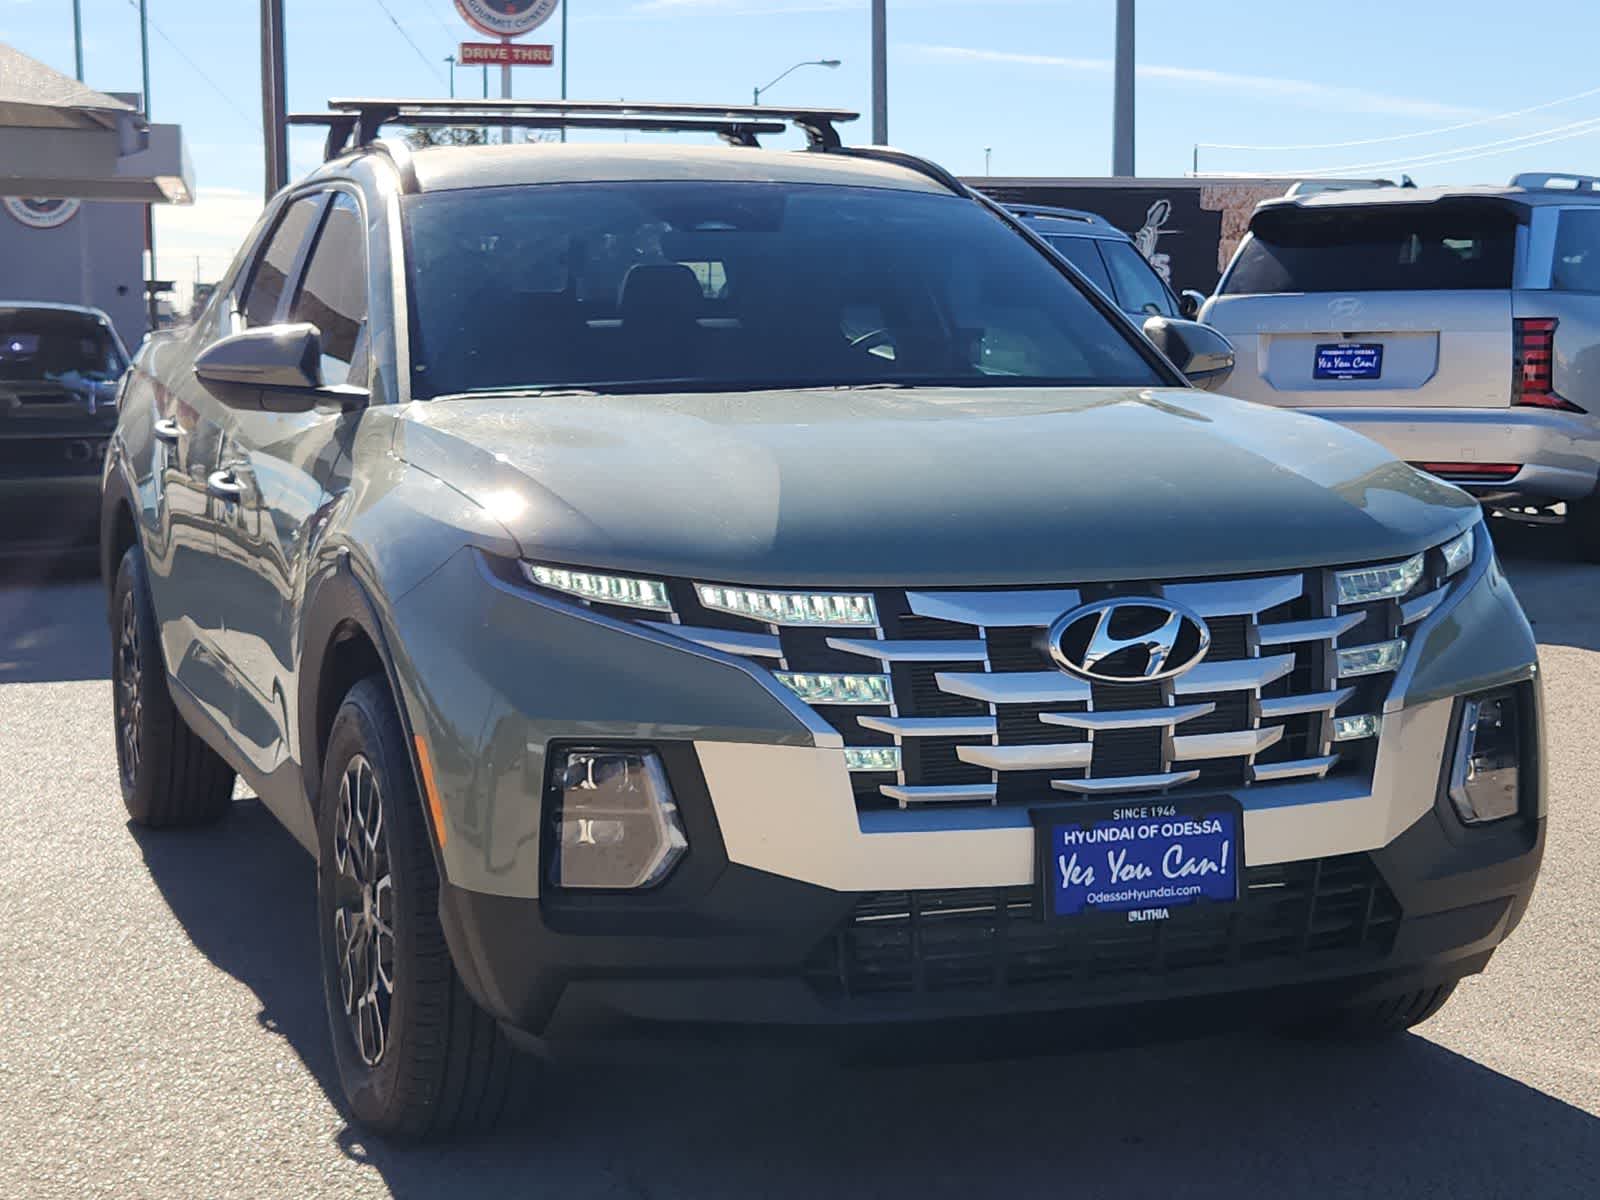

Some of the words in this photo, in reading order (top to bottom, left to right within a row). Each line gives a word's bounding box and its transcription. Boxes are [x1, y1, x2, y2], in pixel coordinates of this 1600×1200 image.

[463, 48, 509, 60] DRIVE
[513, 49, 552, 61] THRU
[1318, 357, 1332, 368] Yes
[1334, 357, 1350, 368] You
[1352, 356, 1377, 368] Can!
[1112, 808, 1147, 820] SINCE
[1151, 805, 1176, 817] 1946
[1064, 827, 1134, 846] HYUNDAI
[1138, 825, 1158, 839] OF
[1161, 819, 1222, 837] ODESSA
[1058, 852, 1095, 889] Yes
[1107, 848, 1152, 884] You
[1162, 840, 1229, 879] Can!
[1087, 884, 1201, 904] OdessaHyundai.com
